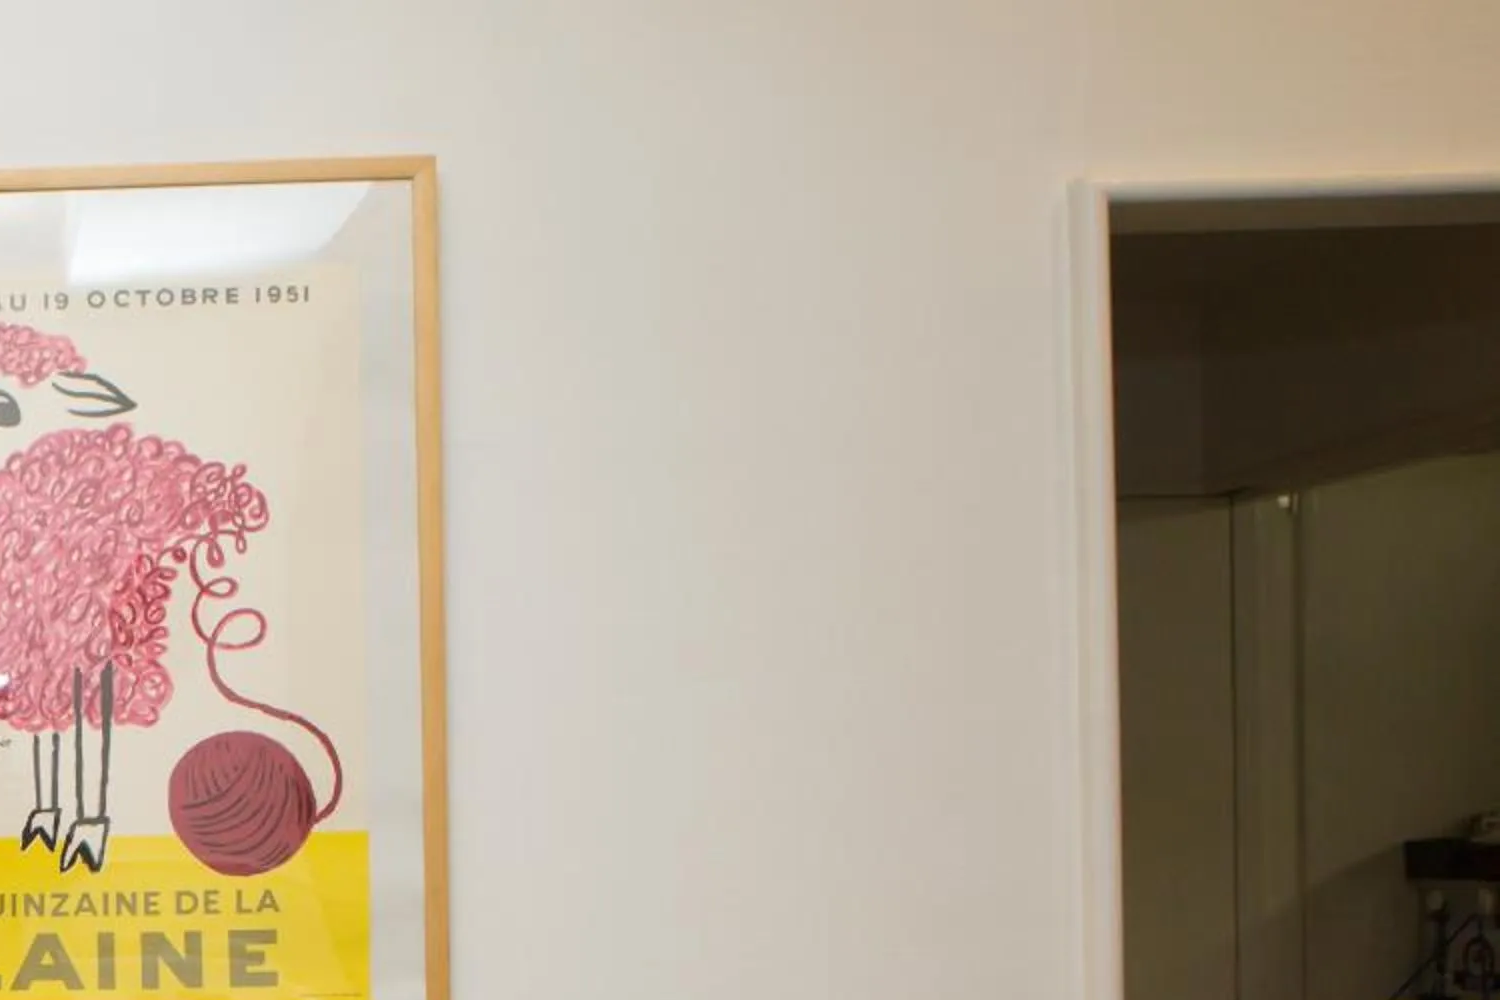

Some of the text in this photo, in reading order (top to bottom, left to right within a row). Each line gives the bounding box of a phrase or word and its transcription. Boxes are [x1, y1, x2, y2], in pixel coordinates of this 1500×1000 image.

[43, 292, 69, 310] 19
[87, 287, 240, 308] OCTOBRE
[255, 285, 309, 303] 1951
[175, 889, 221, 916] DE
[235, 889, 280, 915] LA
